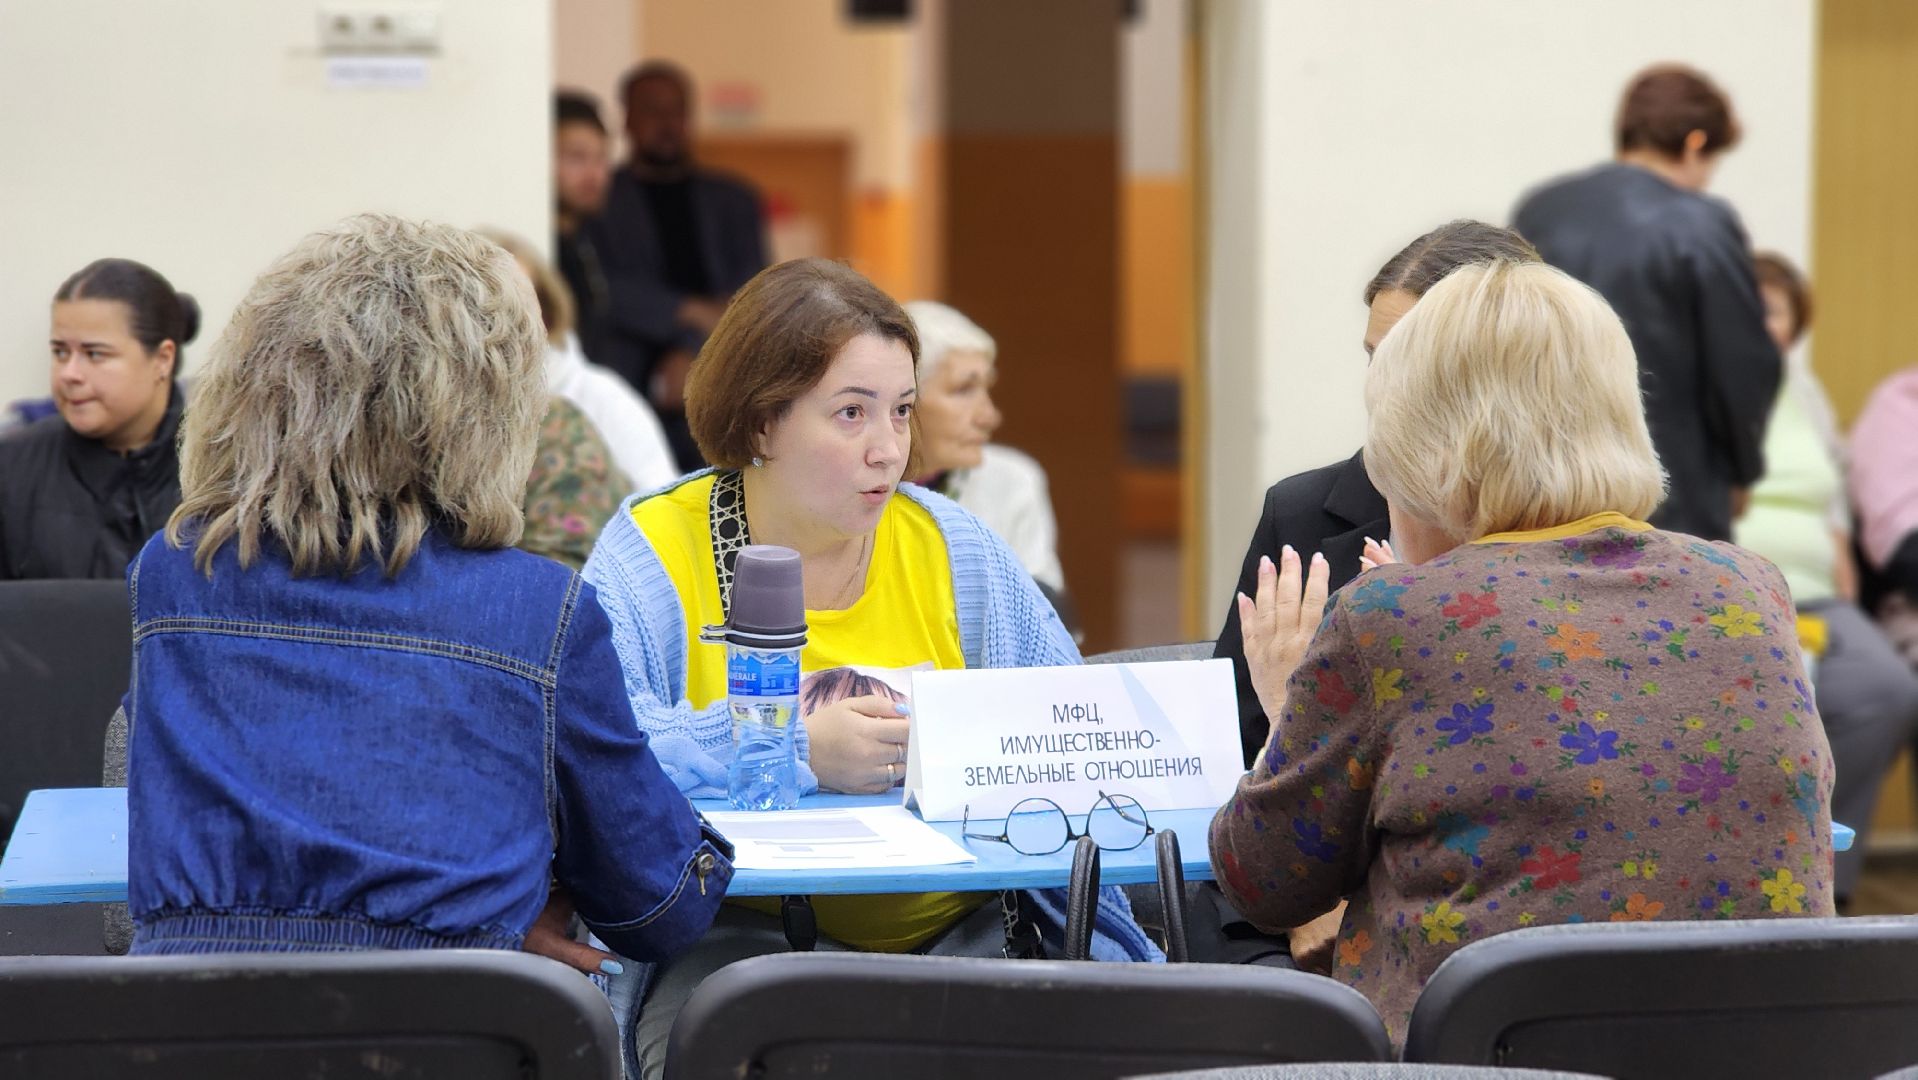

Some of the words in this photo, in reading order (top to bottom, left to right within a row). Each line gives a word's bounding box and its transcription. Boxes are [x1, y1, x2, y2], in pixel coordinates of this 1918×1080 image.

[1053, 703, 1104, 725] МФЦ,
[1000, 730, 1161, 756] ИМУЩЕСТВЕННО-
[965, 763, 1076, 786] ЗЕМЕЛЬНЫЕ
[1085, 757, 1203, 780] ОТНОШЕНИЯ
